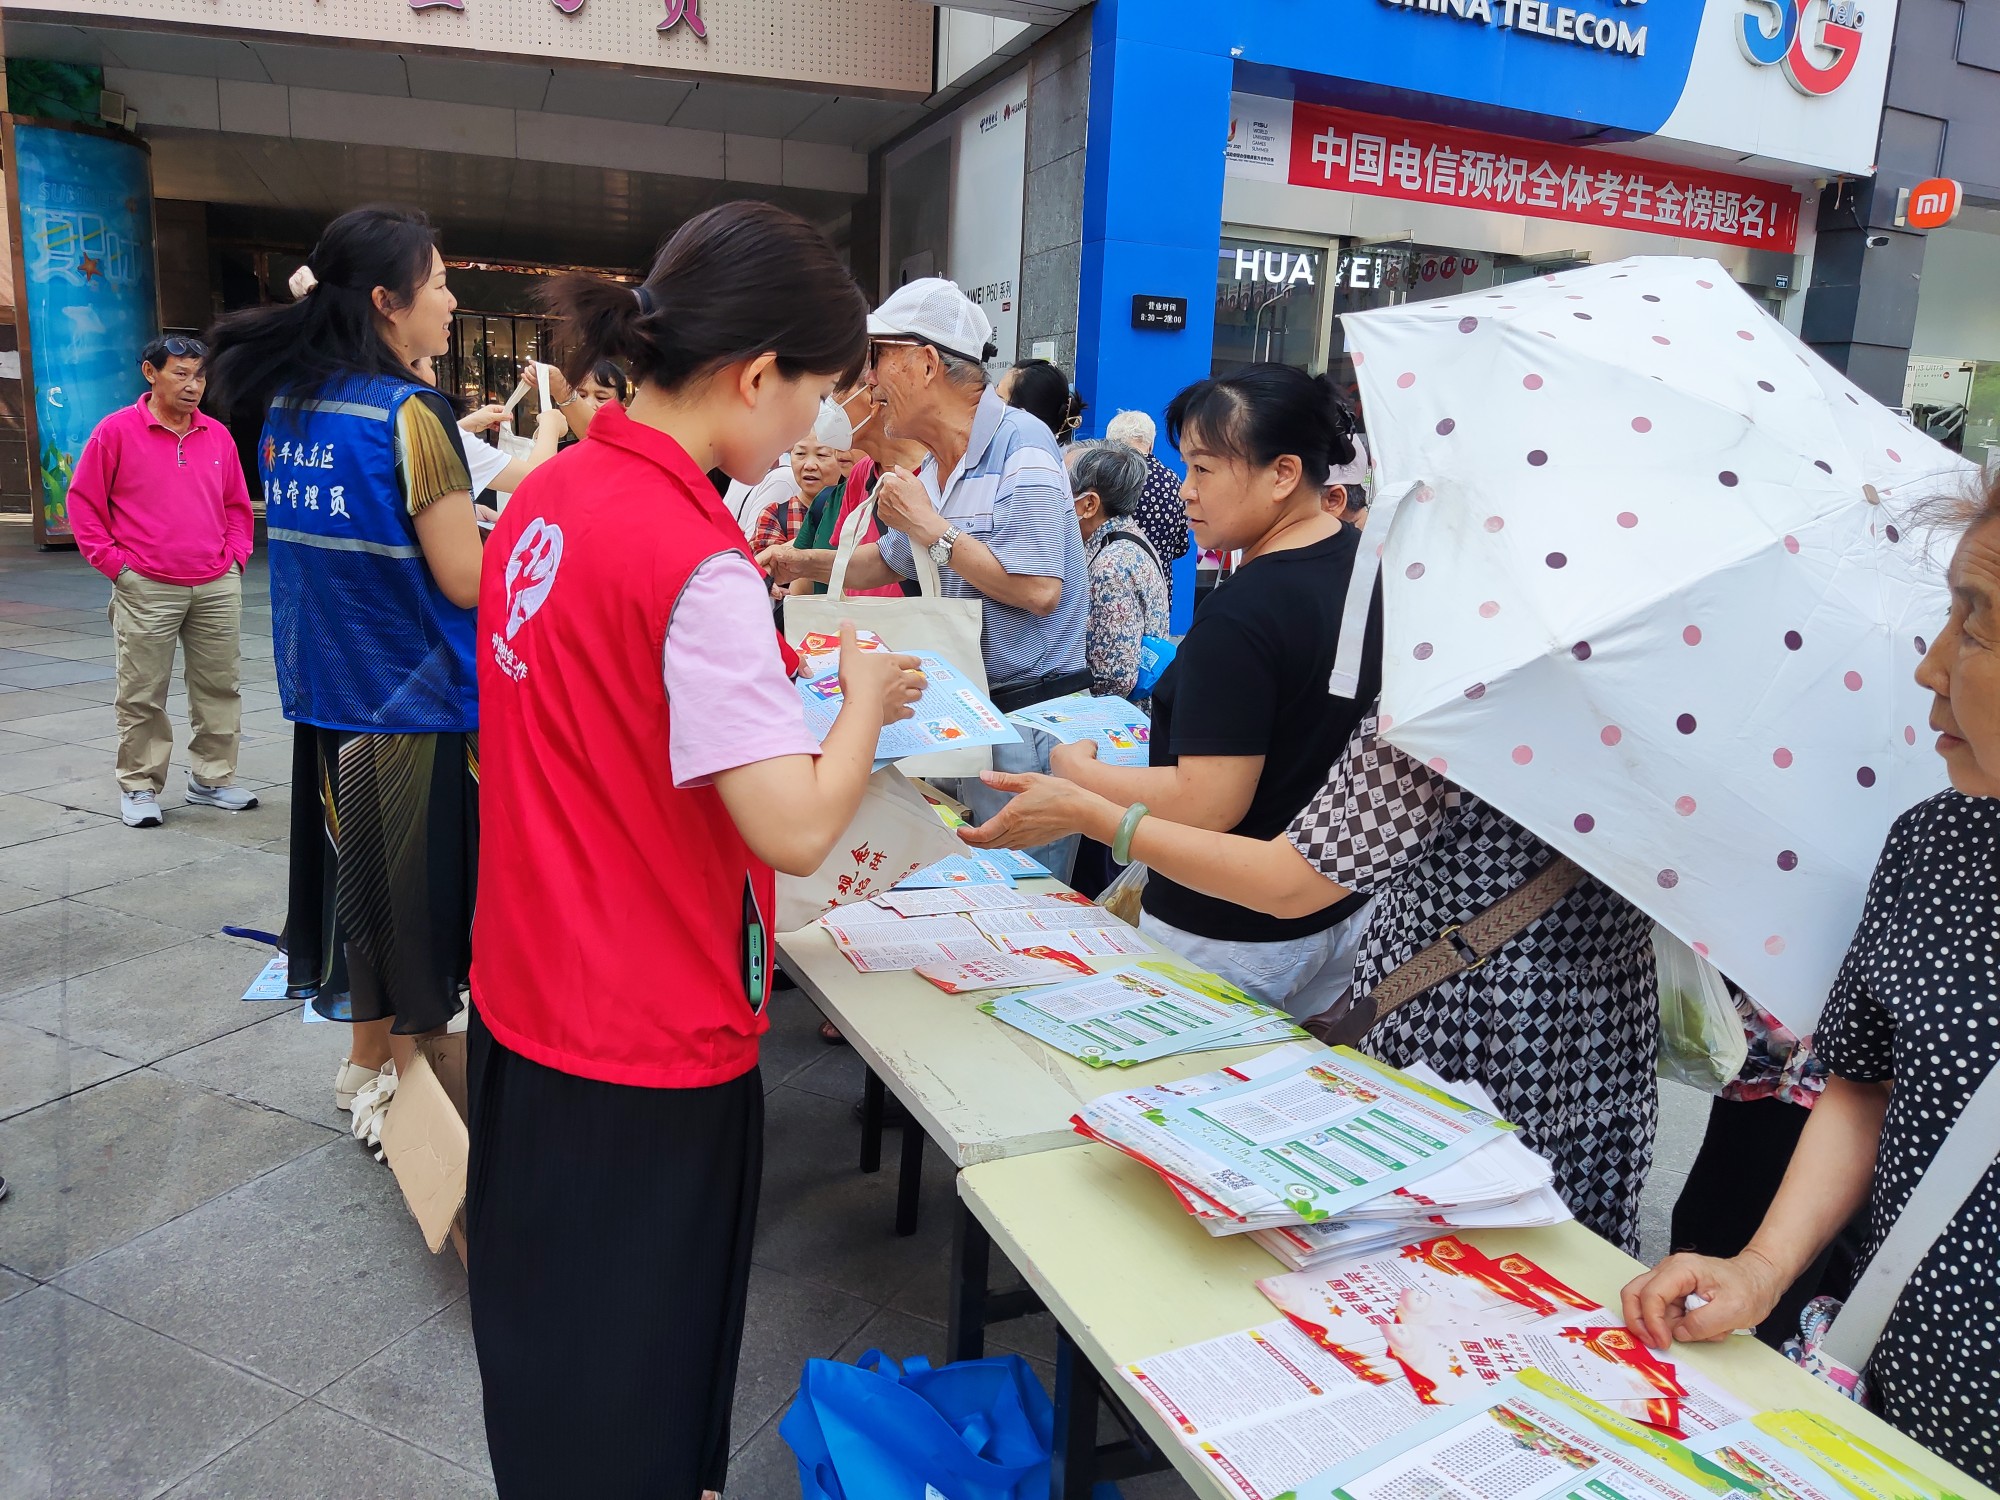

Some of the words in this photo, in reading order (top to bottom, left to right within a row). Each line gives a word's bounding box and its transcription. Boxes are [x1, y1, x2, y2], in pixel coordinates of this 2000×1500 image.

[1380, 0, 1492, 24] INA
[1499, 0, 1648, 57] TELECOM
[1147, 301, 1177, 312] 营业时间
[1459, 1340, 1501, 1387] 军报国
